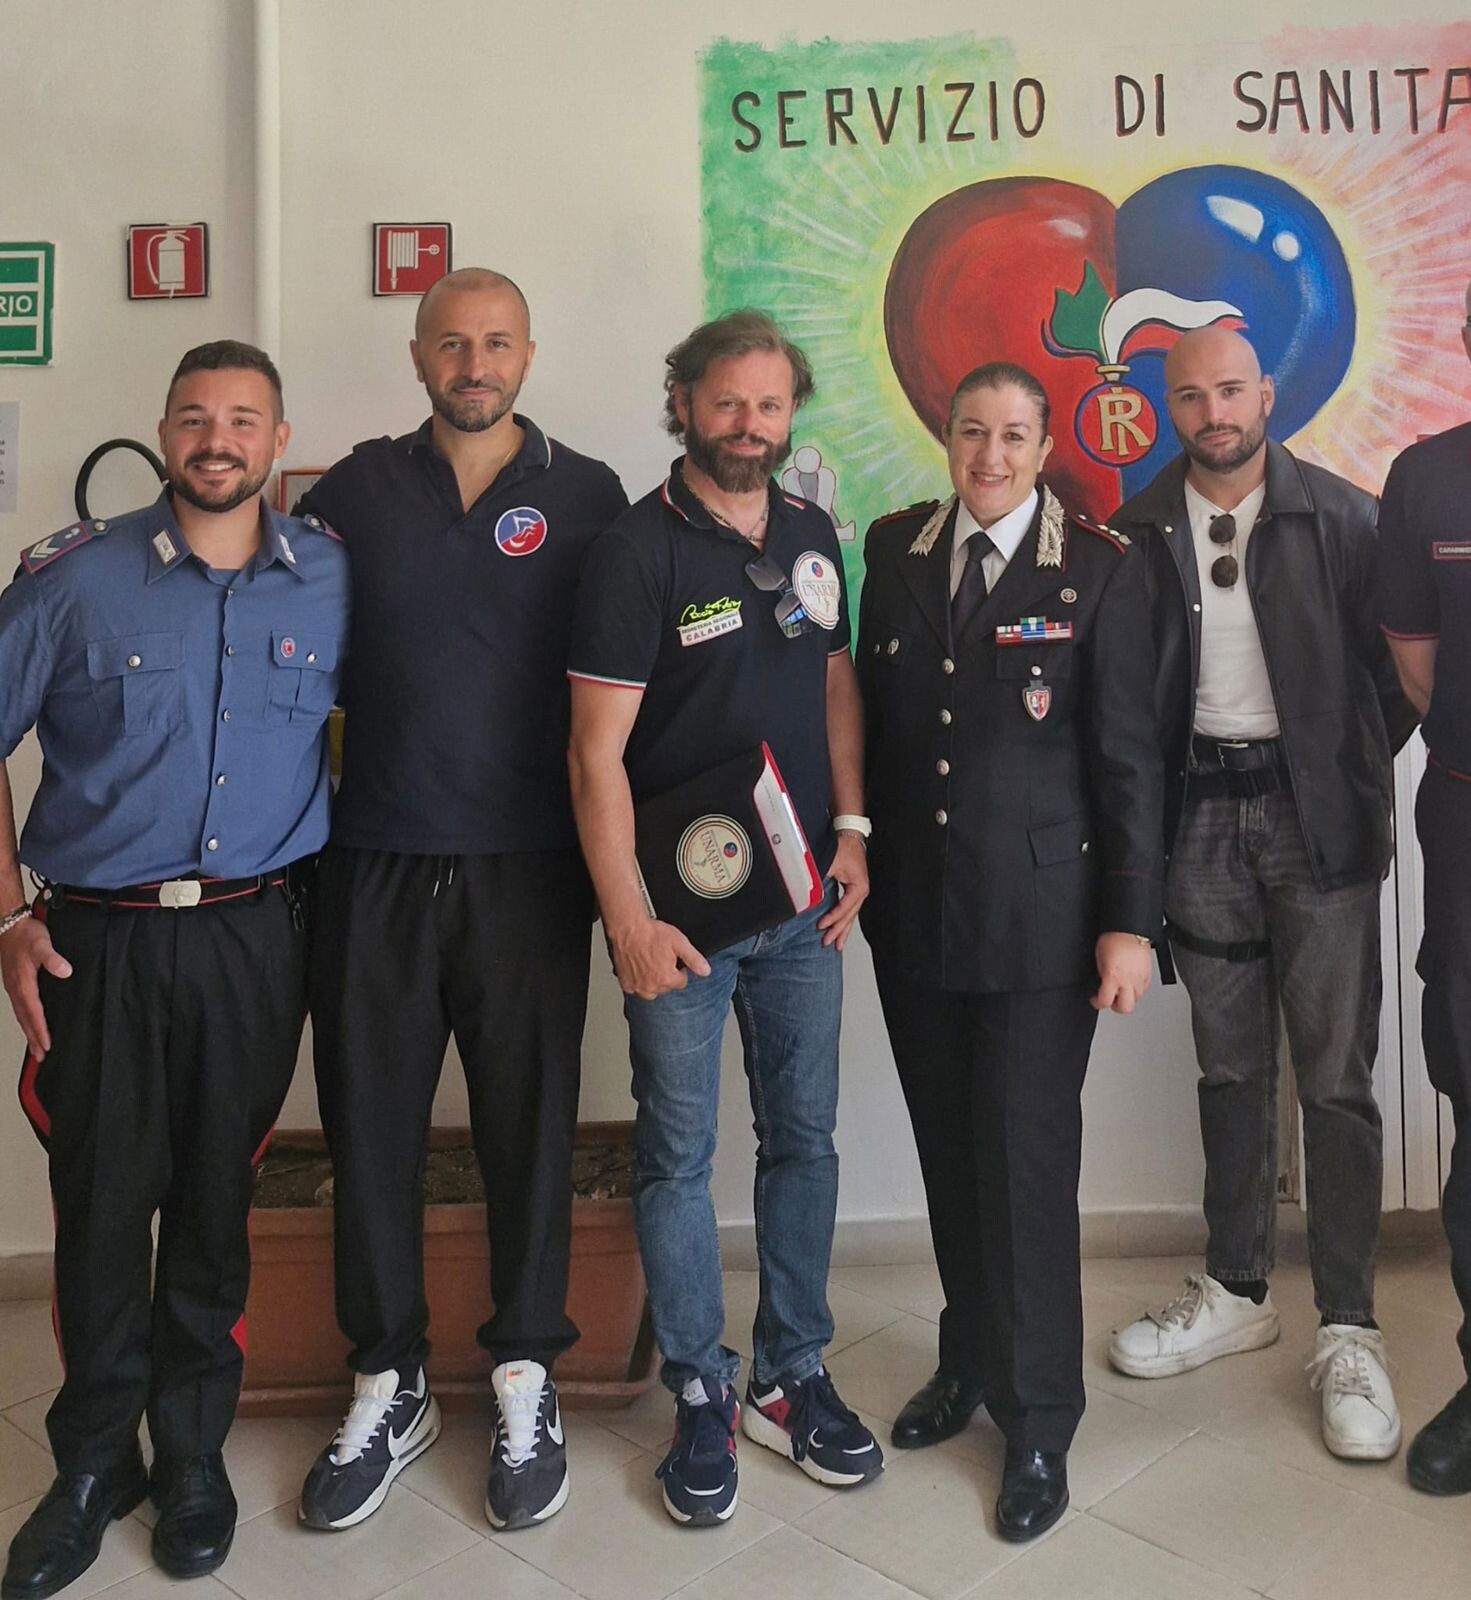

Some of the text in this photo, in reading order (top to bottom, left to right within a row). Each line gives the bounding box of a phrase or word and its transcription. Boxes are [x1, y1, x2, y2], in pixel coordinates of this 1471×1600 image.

[731, 78, 1046, 153] SERVIZIO
[1114, 73, 1165, 137] DI
[686, 618, 738, 641] CALABRIA
